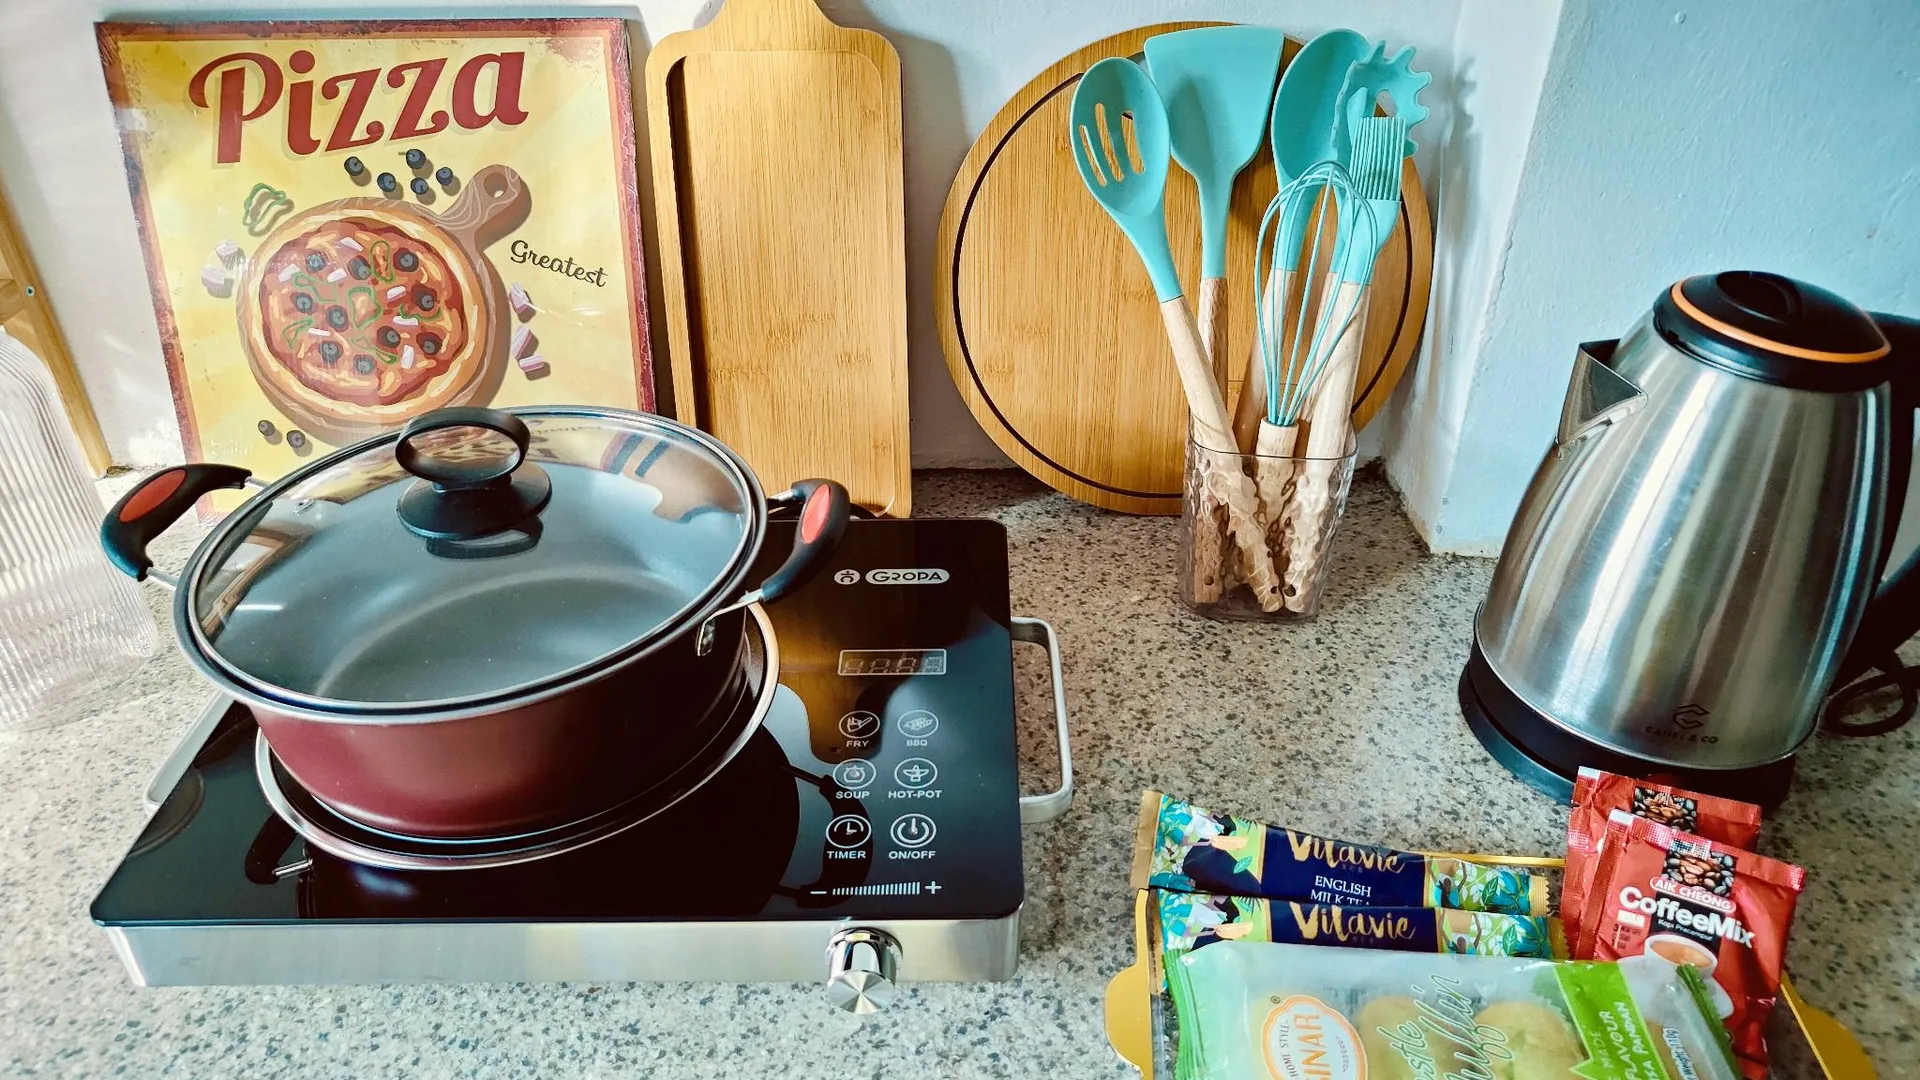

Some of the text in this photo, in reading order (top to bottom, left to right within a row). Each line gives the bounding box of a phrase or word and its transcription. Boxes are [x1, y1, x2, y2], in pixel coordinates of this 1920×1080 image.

[188, 49, 530, 165] Pizza
[510, 239, 608, 288] Greatest
[872, 571, 943, 582] GROPA
[846, 740, 869, 748] FRY
[906, 739, 928, 747] BBQ
[1701, 736, 1719, 744] CO
[835, 790, 870, 799] SOUP
[888, 790, 942, 799] HOT-POT
[827, 850, 866, 859] TIMER
[888, 850, 936, 860] ON/OFF
[1314, 875, 1372, 897] ENGLISH
[1654, 879, 1732, 910] AIK CHEONG
[1310, 889, 1345, 905] MILK
[1619, 886, 1756, 949] CoffeeMix
[1614, 1001, 1649, 1055] PANDAN
[1279, 1023, 1299, 1078] HOME STYLE
[1293, 1013, 1332, 1080] INAR
[1376, 1020, 1436, 1080] stle
